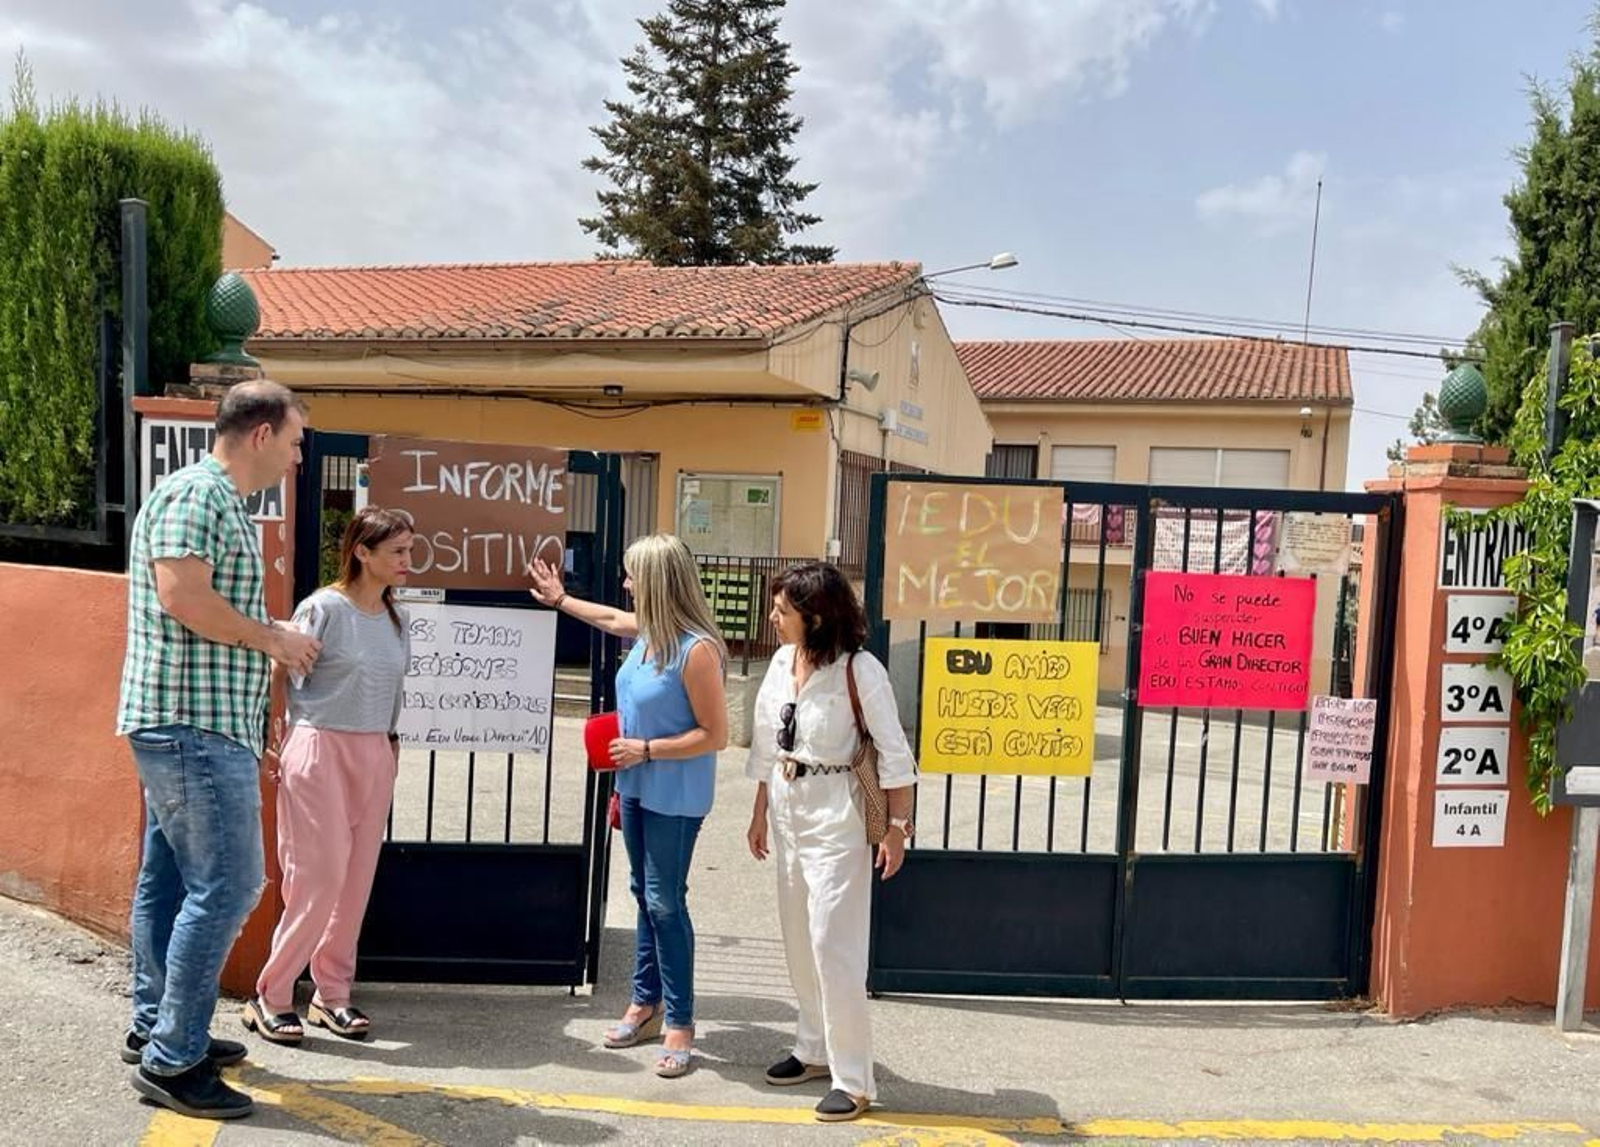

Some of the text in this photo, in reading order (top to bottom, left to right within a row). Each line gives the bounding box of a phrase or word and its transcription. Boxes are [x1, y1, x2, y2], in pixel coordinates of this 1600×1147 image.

[401, 450, 565, 513] INFORME
[387, 508, 565, 575] OSITIVO
[955, 542, 994, 568] EL
[1442, 514, 1538, 588] ENTRA
[1173, 584, 1282, 612] No se puede
[1195, 611, 1263, 625] suspender
[1452, 616, 1507, 644] 4ºA
[451, 621, 523, 648] TOMAN
[1179, 626, 1222, 648] BUEN
[1232, 631, 1287, 650] HACER
[407, 652, 518, 681] ECISIONES
[946, 649, 1071, 680] EDU AMIGO
[1199, 650, 1232, 669] GRAN
[1236, 652, 1303, 674] DIRECTOR
[938, 687, 1082, 721] HUETOR VEGA
[1447, 685, 1504, 713] 3ºA
[1004, 728, 1083, 757] CONTIGO
[1442, 748, 1500, 775] 2ºA
[1444, 803, 1497, 815] Infantil
[1456, 825, 1481, 836] 4 A
